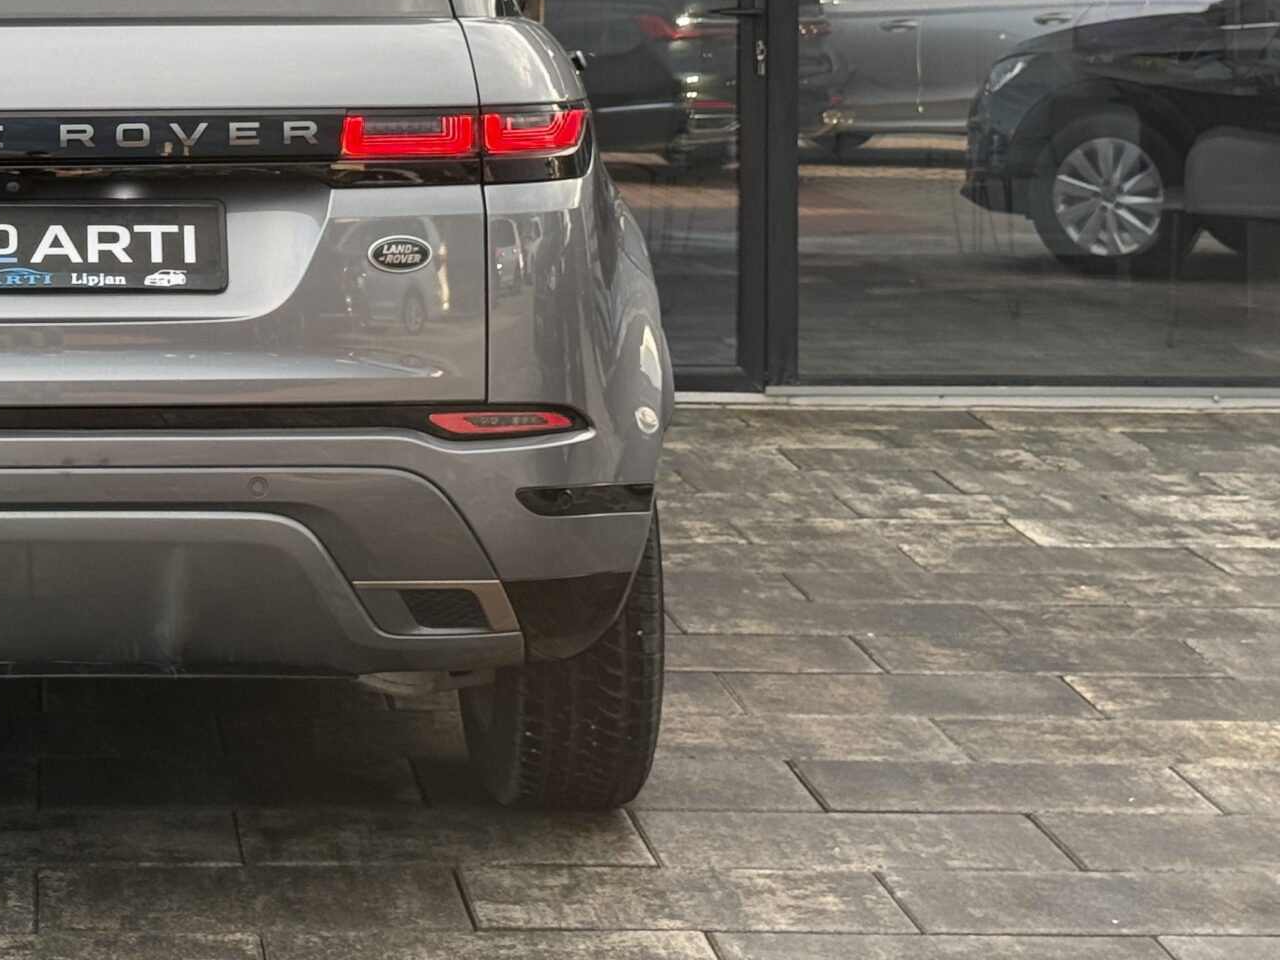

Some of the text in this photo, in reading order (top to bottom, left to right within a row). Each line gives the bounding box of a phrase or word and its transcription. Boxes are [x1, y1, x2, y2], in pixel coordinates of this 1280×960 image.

[59, 121, 319, 148] ROVER
[30, 225, 196, 263] ARTI
[71, 273, 126, 287] Lipjan
